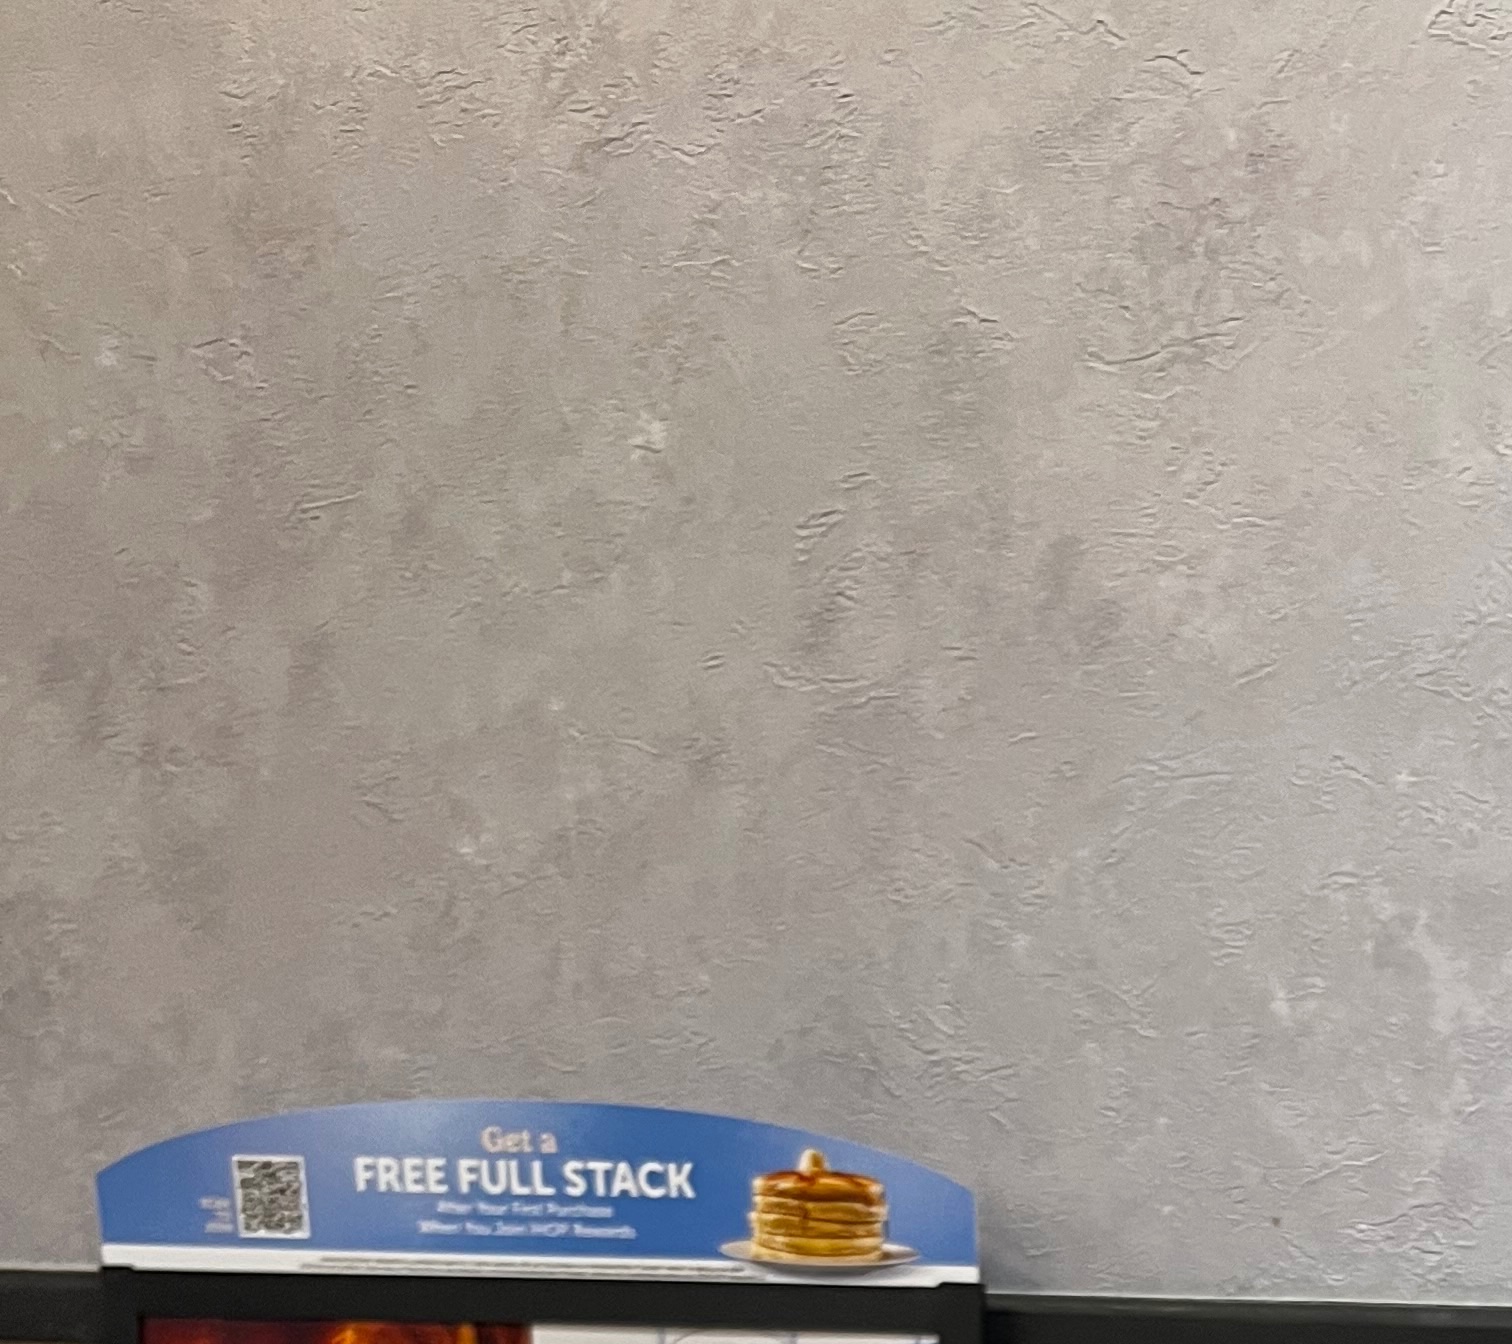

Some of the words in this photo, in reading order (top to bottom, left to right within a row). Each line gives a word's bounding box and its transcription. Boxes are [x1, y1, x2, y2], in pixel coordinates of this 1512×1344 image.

[480, 1125, 533, 1153] Get
[539, 1133, 558, 1154] a
[354, 1156, 448, 1194] FREE
[458, 1158, 556, 1197] FULL
[562, 1160, 697, 1200] STACK
